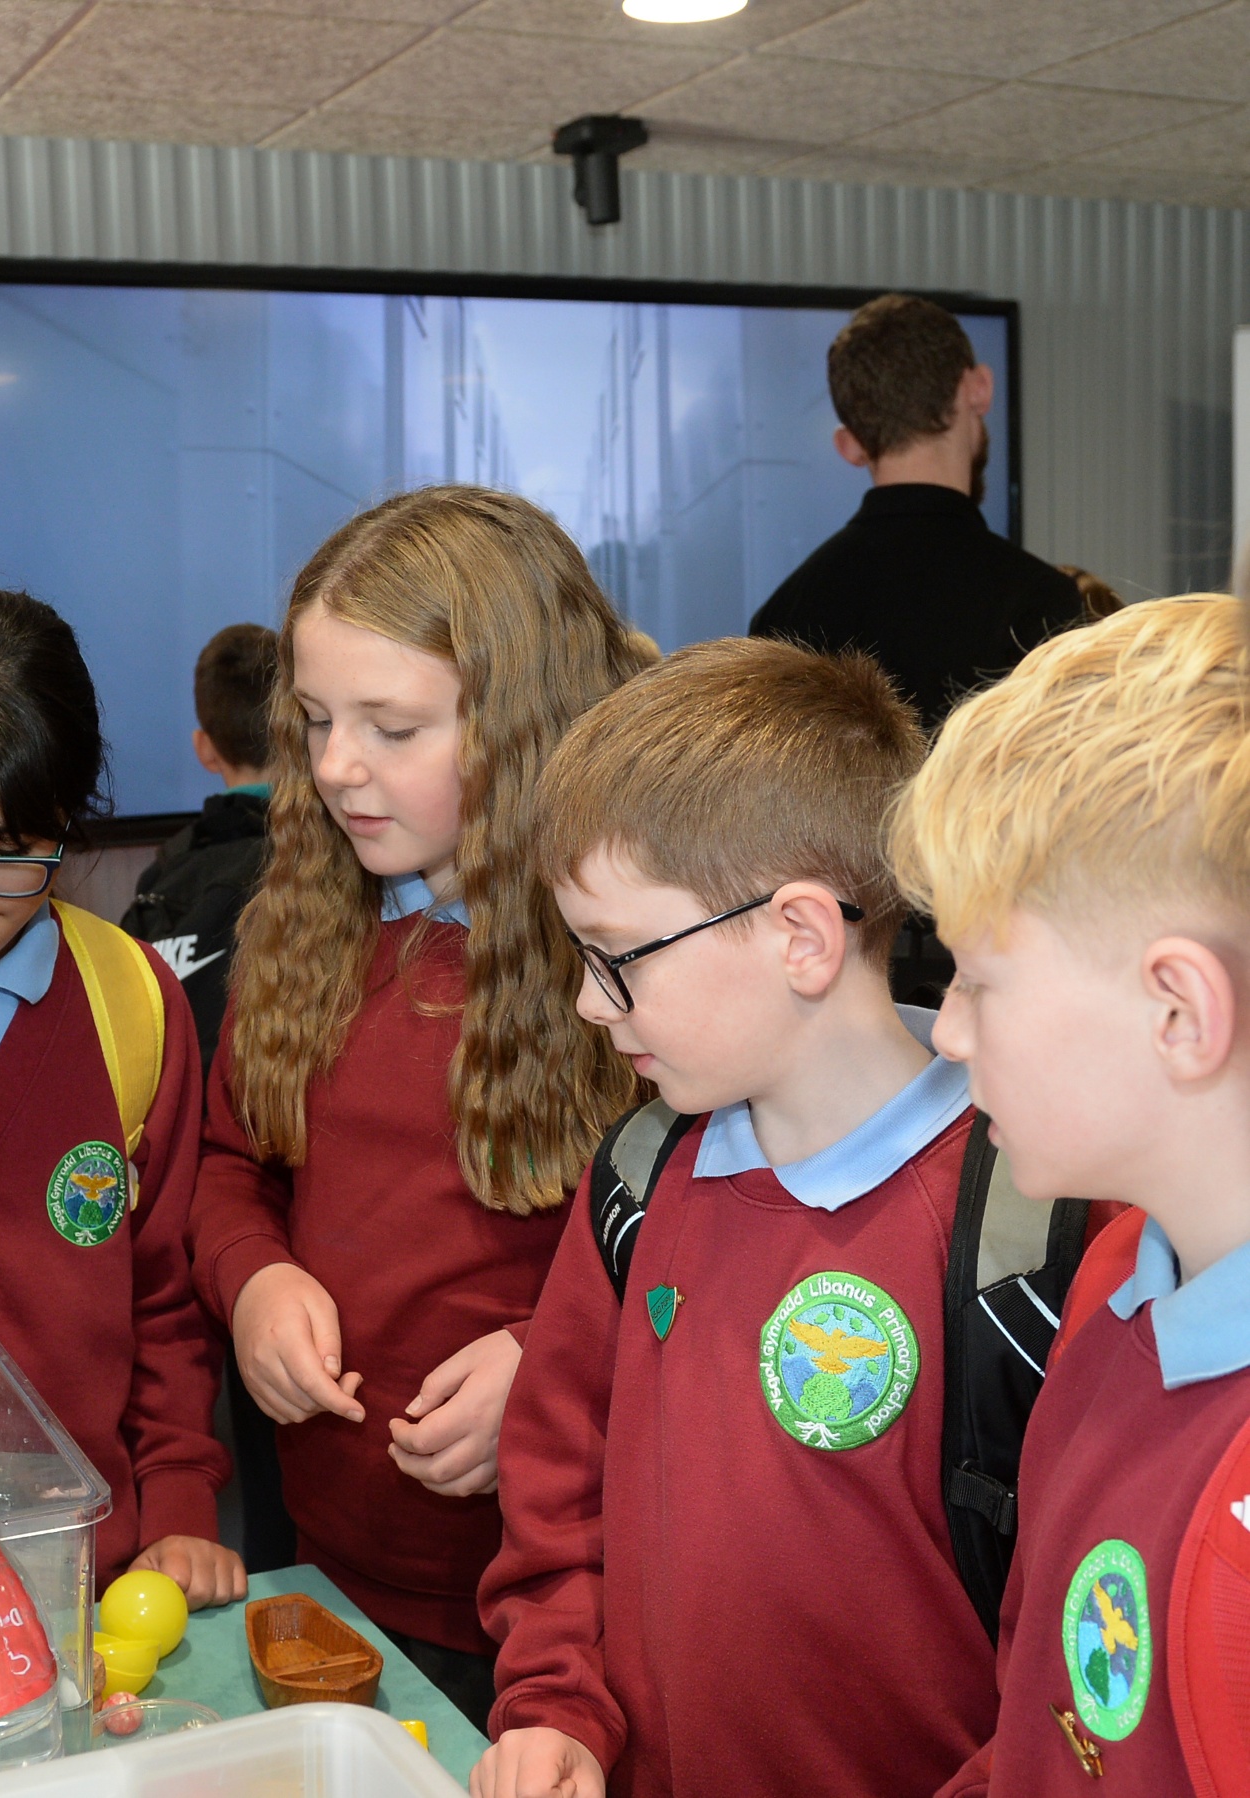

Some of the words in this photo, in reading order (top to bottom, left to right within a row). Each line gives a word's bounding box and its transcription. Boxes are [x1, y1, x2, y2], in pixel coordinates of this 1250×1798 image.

[78, 1145, 113, 1160] Libanus
[808, 1276, 877, 1308] Libanus
[763, 1288, 805, 1357] Gynradd
[878, 1307, 912, 1381] Primary
[759, 1360, 784, 1411] Ysgol
[864, 1381, 909, 1436] School
